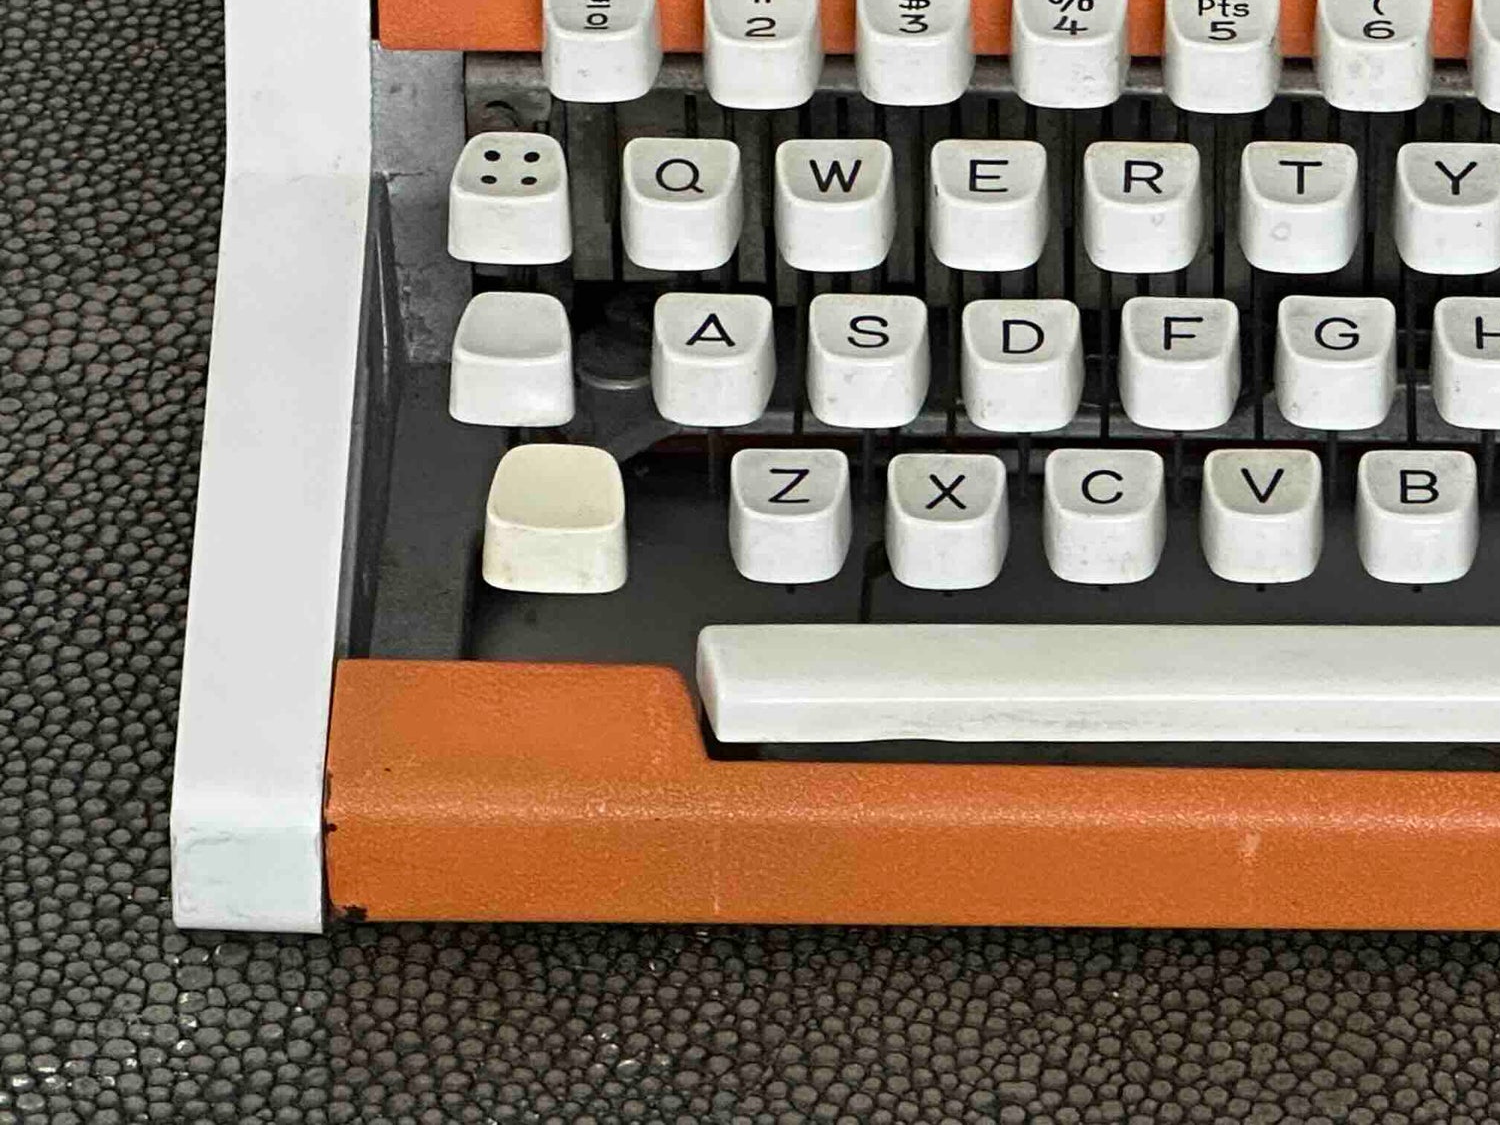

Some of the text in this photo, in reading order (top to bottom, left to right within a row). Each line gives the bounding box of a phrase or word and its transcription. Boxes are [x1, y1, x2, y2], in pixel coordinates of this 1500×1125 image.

[745, 17, 776, 37] 2
[899, 14, 928, 33] 3
[1053, 16, 1088, 35] 4
[1208, 21, 1237, 41] 5
[1363, 20, 1395, 39] 6
[656, 159, 704, 193] Q
[809, 160, 862, 193] W
[969, 160, 1008, 192] E
[1124, 160, 1163, 194] R
[1279, 161, 1322, 194] T
[1435, 161, 1477, 195] Y
[686, 313, 735, 347] A
[848, 316, 889, 348] S
[1003, 320, 1044, 354] D
[1164, 317, 1203, 350] F
[1315, 317, 1359, 350] G
[768, 469, 810, 503] Z
[926, 474, 966, 509] X
[1082, 470, 1123, 504] C
[1241, 468, 1284, 503] V
[1400, 470, 1439, 504] B
